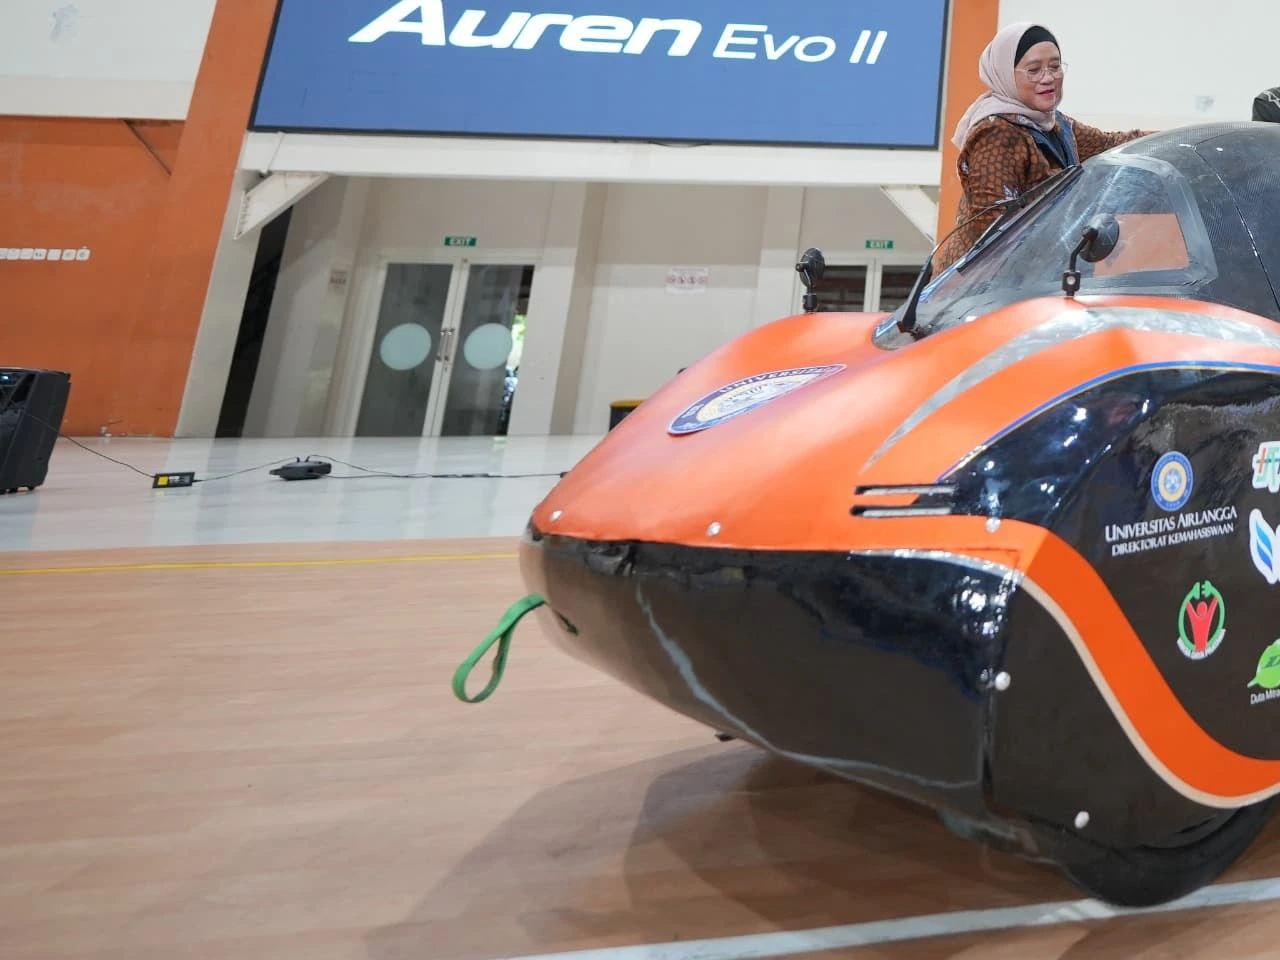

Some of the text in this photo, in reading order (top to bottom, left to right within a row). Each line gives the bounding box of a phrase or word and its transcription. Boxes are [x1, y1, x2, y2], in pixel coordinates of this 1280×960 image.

[713, 24, 836, 62] Evo
[1104, 505, 1238, 542] UNIVERSITAS AIRLANGGA
[1111, 522, 1235, 557] DIREKTORAT KEMAHASISWAAN
